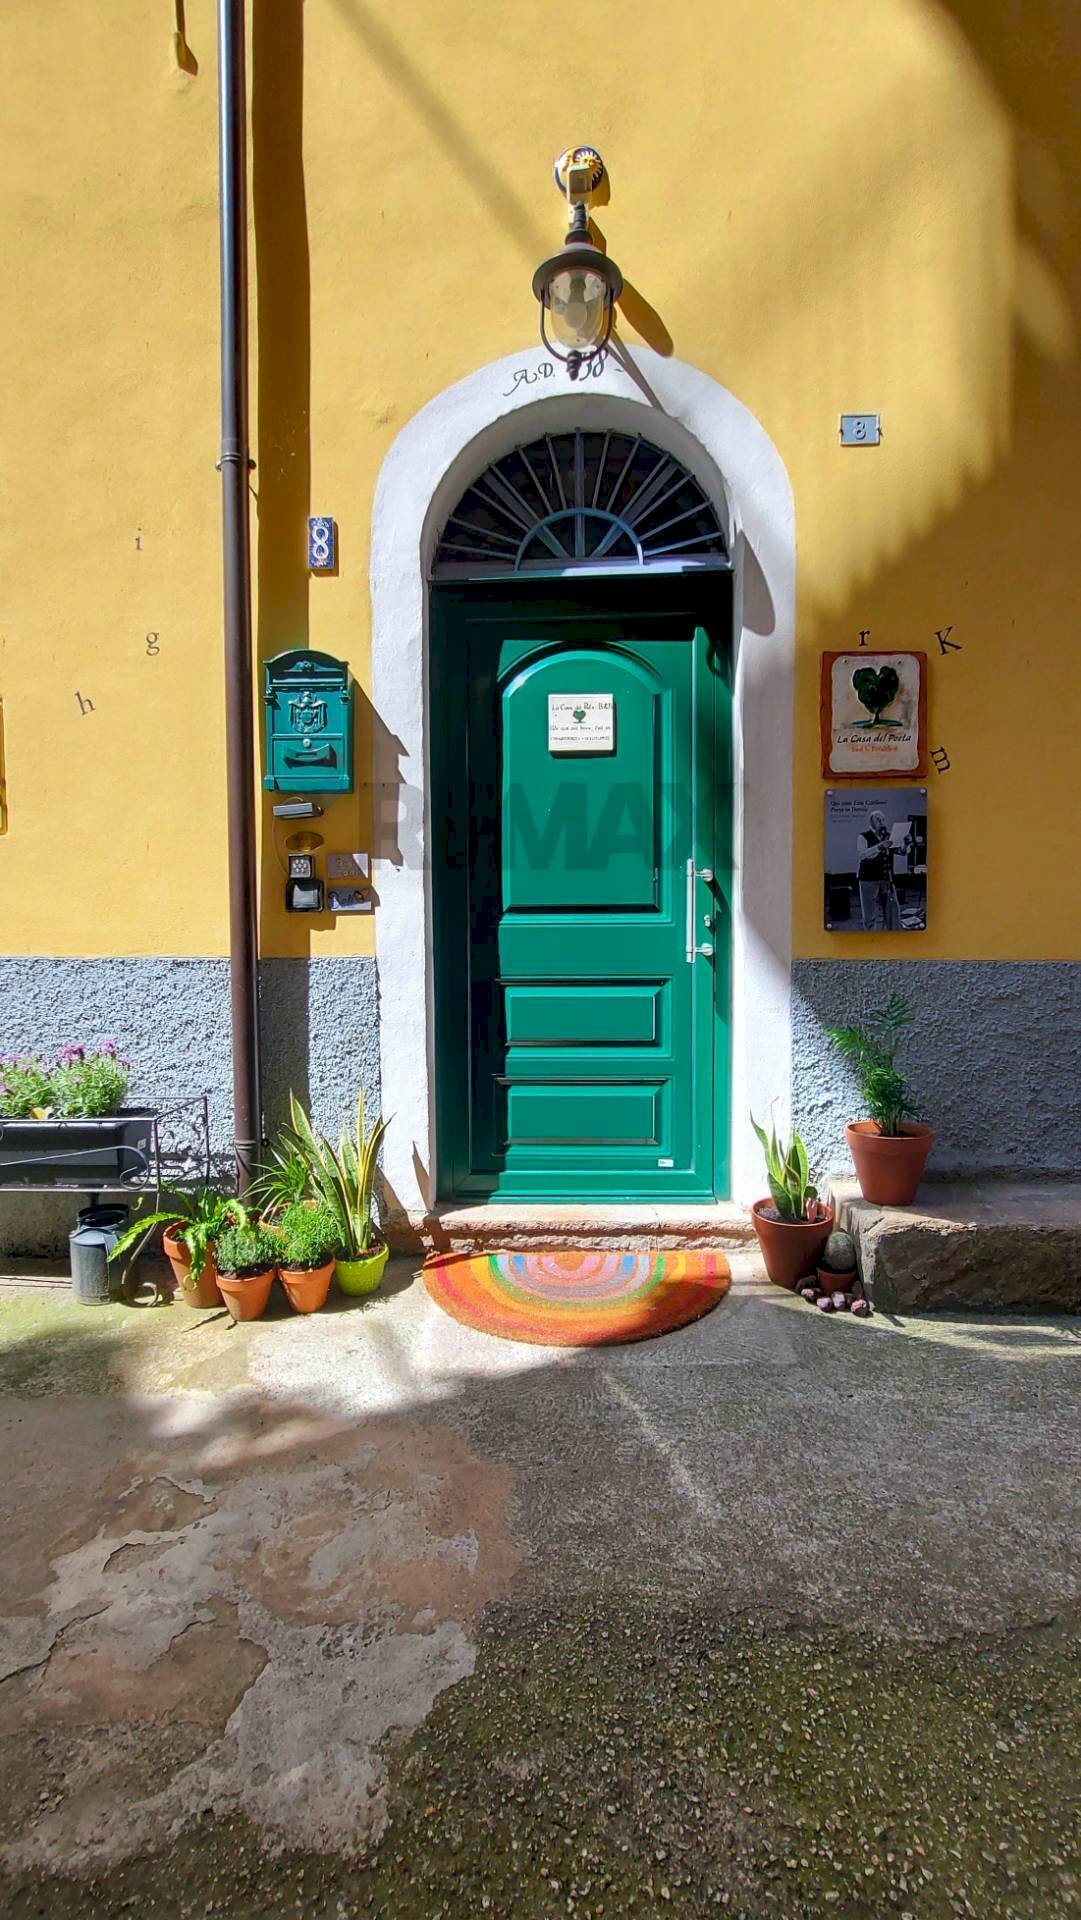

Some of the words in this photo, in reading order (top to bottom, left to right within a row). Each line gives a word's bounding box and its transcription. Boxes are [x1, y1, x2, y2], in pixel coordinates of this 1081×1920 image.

[854, 419, 867, 441] 8
[311, 525, 329, 560] 8
[145, 631, 160, 657] g
[858, 629, 871, 647] r
[934, 626, 963, 656] K
[74, 691, 96, 716] h
[837, 735, 848, 743] La
[850, 734, 871, 743] Casa
[873, 732, 888, 743] del
[929, 746, 951, 775] m
